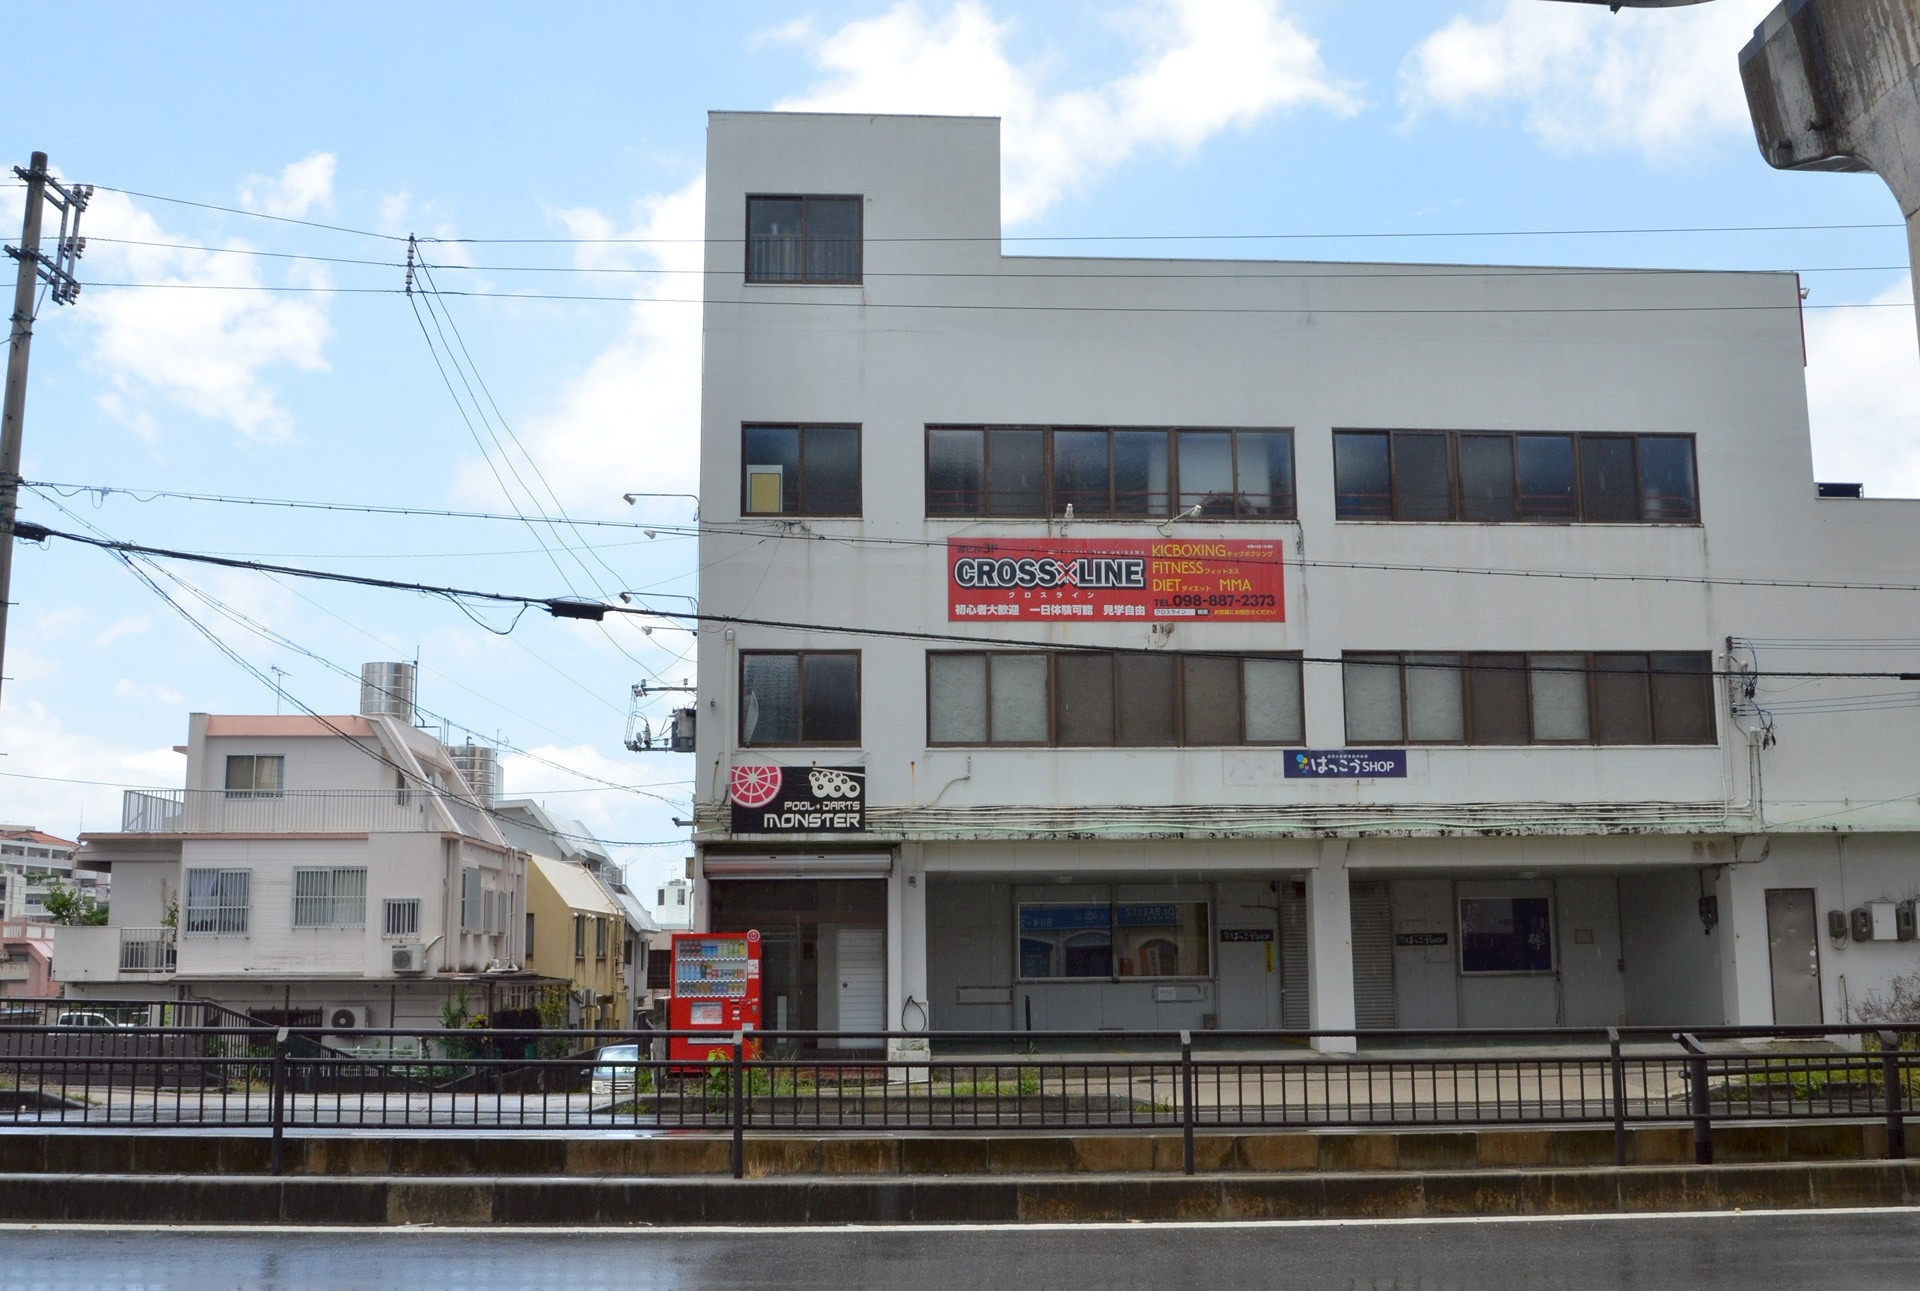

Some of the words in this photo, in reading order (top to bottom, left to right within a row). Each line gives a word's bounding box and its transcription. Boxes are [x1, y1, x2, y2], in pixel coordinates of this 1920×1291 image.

[1151, 544, 1226, 557] KICBOXING
[1152, 561, 1204, 574] FITNESS
[1153, 579, 1182, 592] DIET
[1219, 579, 1252, 592] MMA
[1103, 604, 1146, 616] 見学自由
[822, 801, 860, 810] DARTS
[763, 813, 860, 828] MONSTER
